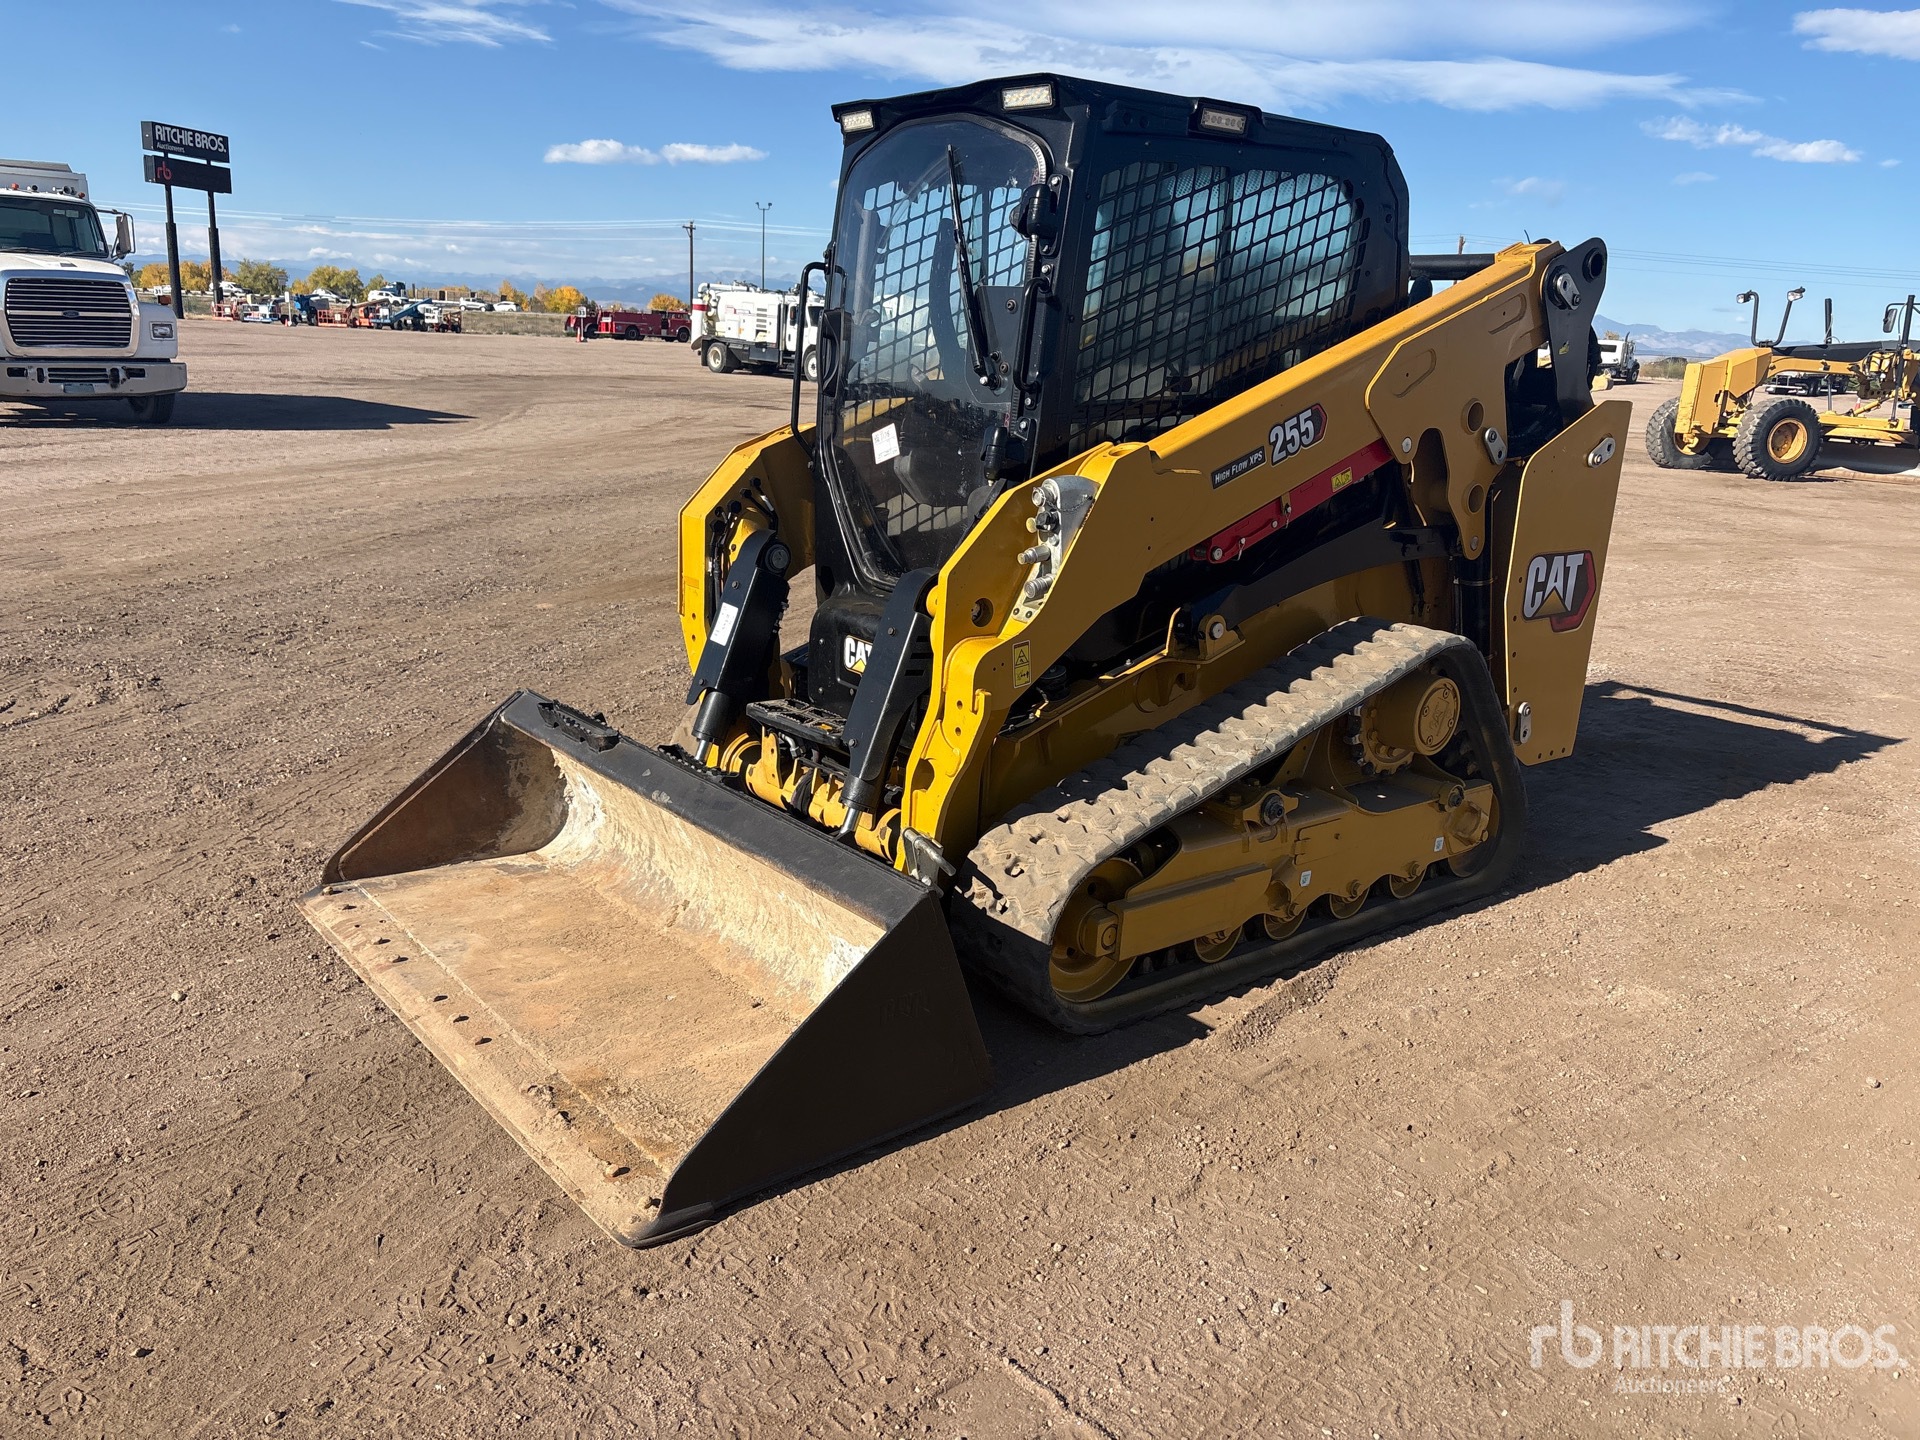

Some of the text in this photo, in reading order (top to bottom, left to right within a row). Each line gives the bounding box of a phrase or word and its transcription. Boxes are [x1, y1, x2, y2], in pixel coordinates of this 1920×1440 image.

[155, 125, 227, 153] RITCHIE BROS.
[156, 161, 172, 180] rb
[1269, 409, 1315, 463] 255
[1249, 450, 1263, 465] XPS
[1523, 553, 1584, 618] CAT
